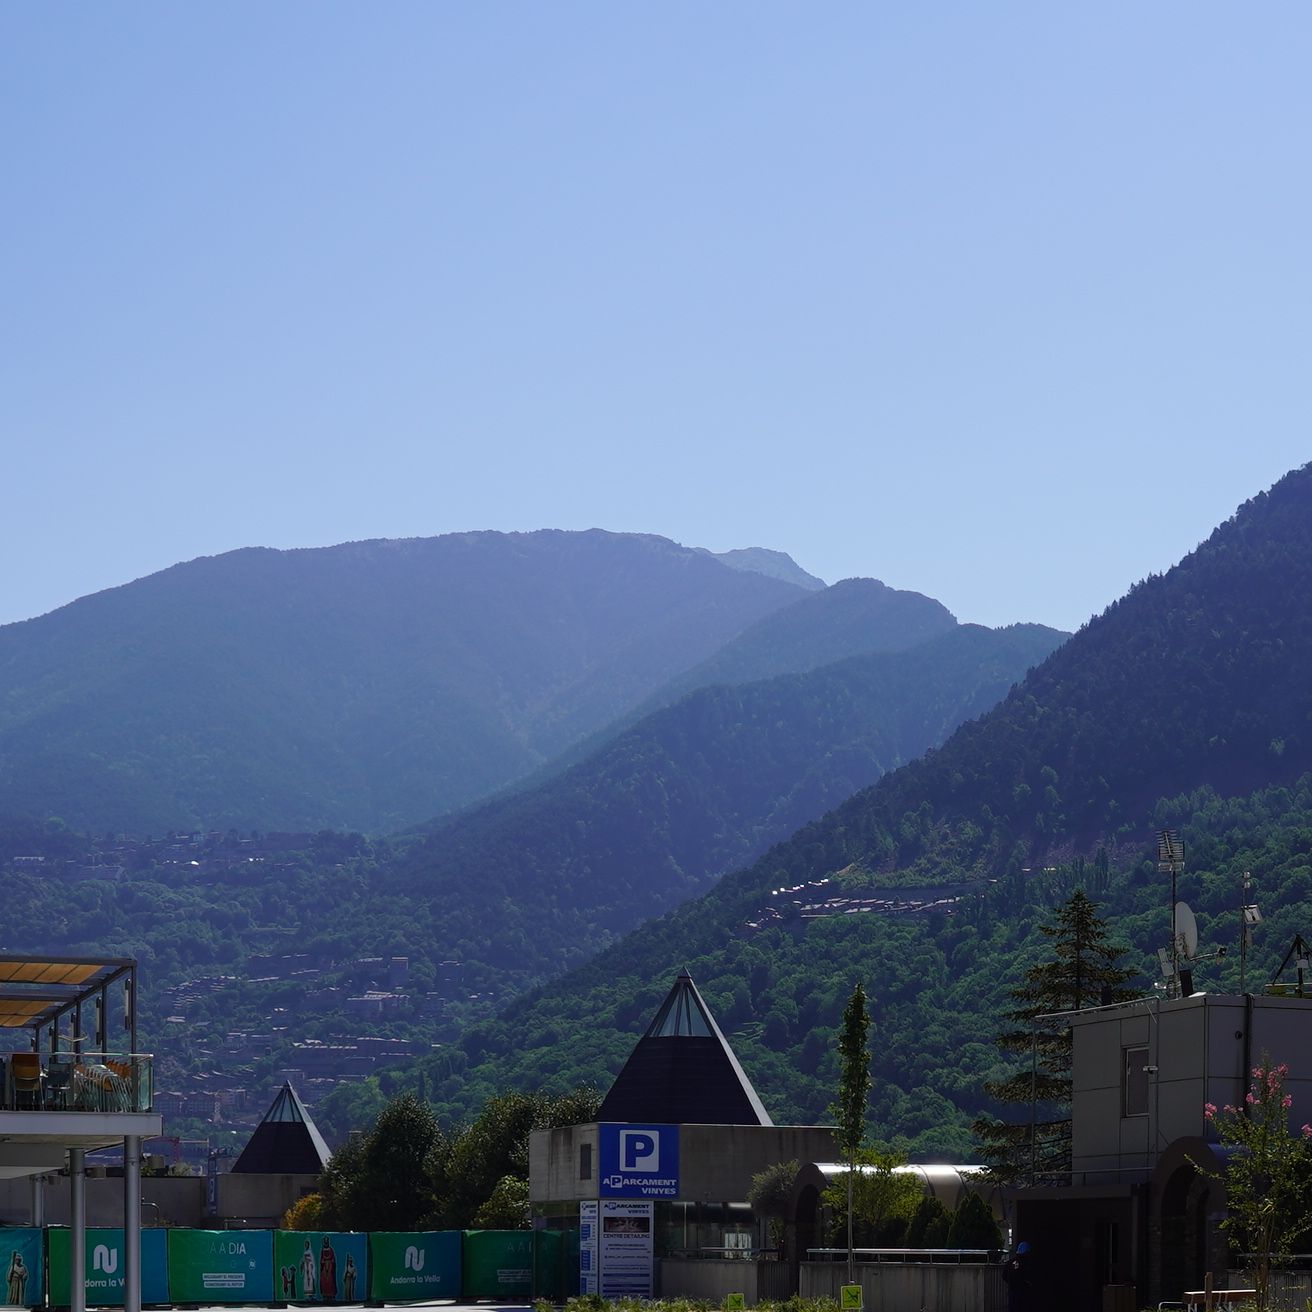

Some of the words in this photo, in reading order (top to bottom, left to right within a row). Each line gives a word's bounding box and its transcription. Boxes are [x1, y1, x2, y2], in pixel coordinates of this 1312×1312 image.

[625, 1133, 655, 1168] P
[602, 1175, 678, 1188] APARCAMENT
[641, 1187, 676, 1195] VINYES
[228, 1242, 247, 1255] DIA
[84, 1278, 107, 1288] dorra
[390, 1275, 416, 1285] Andorra
[416, 1275, 424, 1283] la
[424, 1274, 441, 1283] Vella
